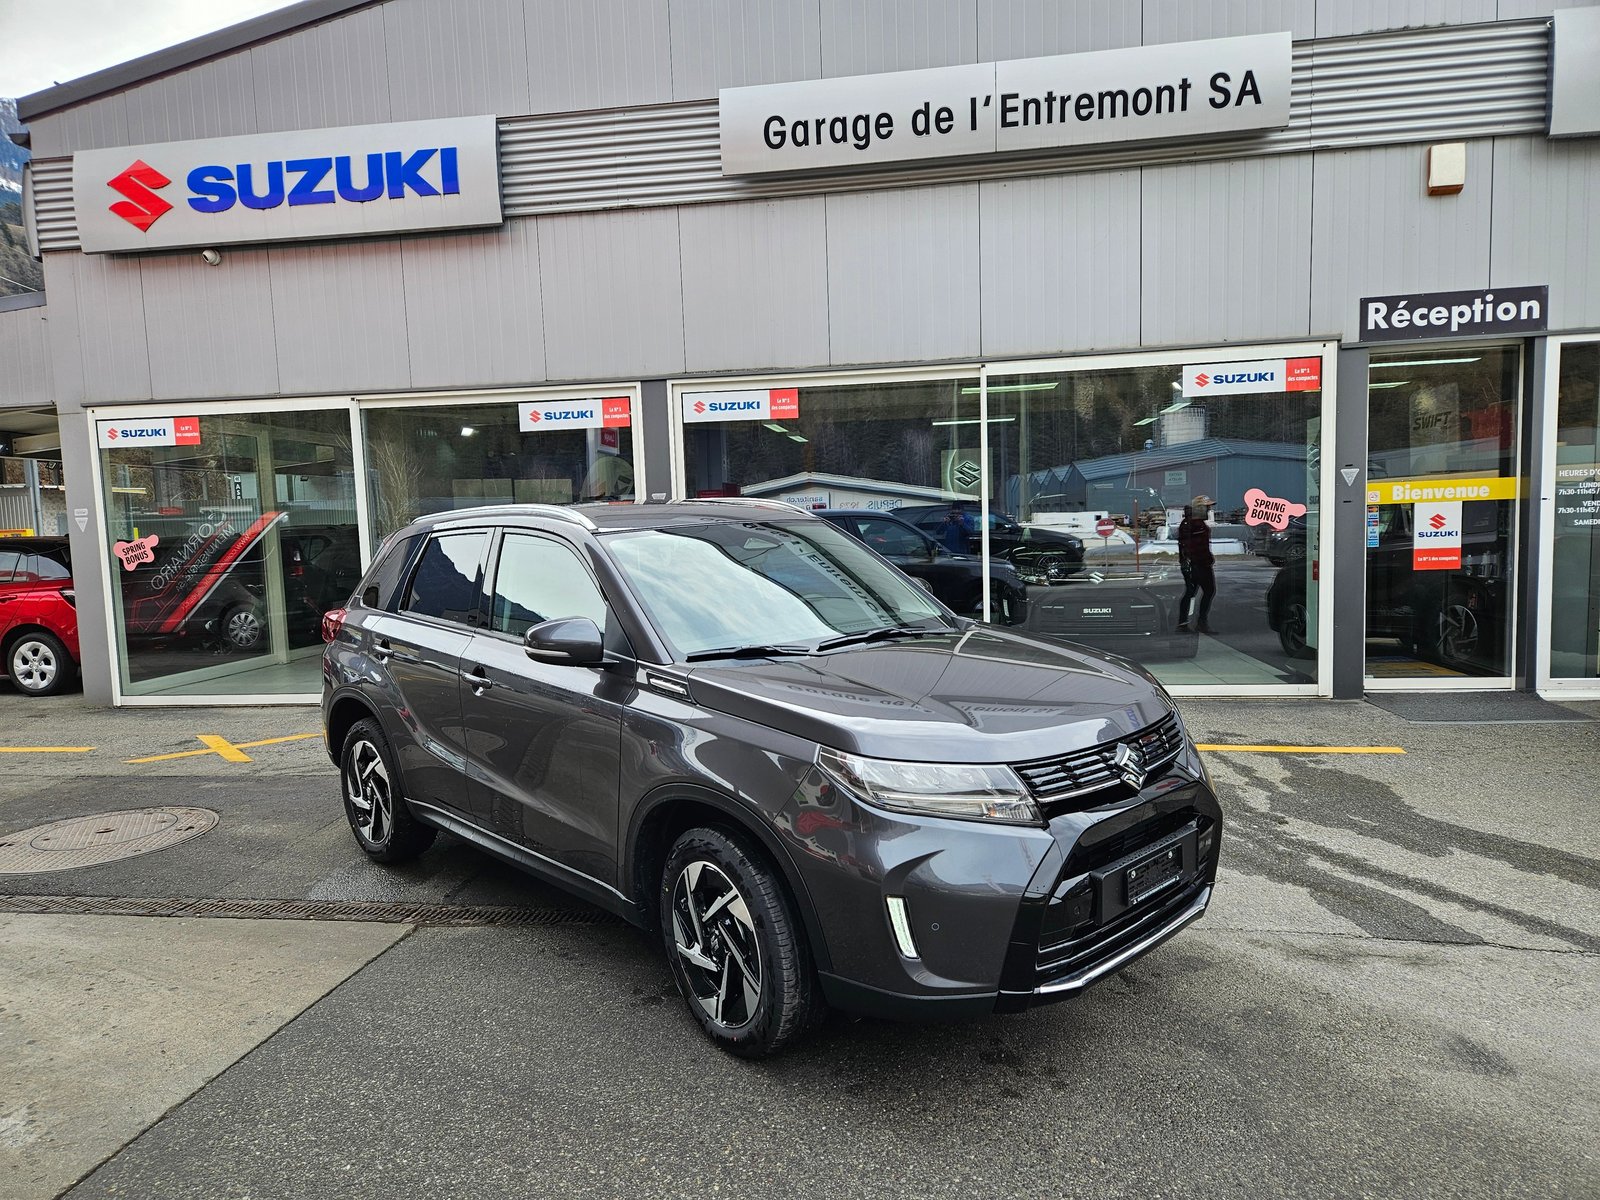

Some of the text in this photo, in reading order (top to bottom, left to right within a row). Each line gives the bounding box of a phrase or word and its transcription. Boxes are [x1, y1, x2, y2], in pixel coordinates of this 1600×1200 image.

[762, 111, 894, 151] Garage
[911, 101, 954, 136] de
[1208, 69, 1263, 109] SA
[187, 147, 460, 213] SUZUKI
[1367, 294, 1541, 332] Réception
[1213, 371, 1275, 385] SUZUKI
[708, 401, 760, 412] SUZUKI
[544, 410, 594, 420] SUZUKI
[1412, 410, 1452, 431] SWIFT
[121, 428, 166, 438] SUZUKI
[1559, 468, 1588, 477] HEURES
[1392, 483, 1490, 501] Bienvenue
[1558, 488, 1596, 496] 7h30-11h45
[1254, 498, 1286, 513] SPRING
[1557, 506, 1596, 514] 7h30-11h45
[1251, 508, 1283, 524] BONUS
[1418, 530, 1458, 538] SUZUKI
[122, 541, 146, 556] SPRING
[125, 550, 149, 565] BONUS
